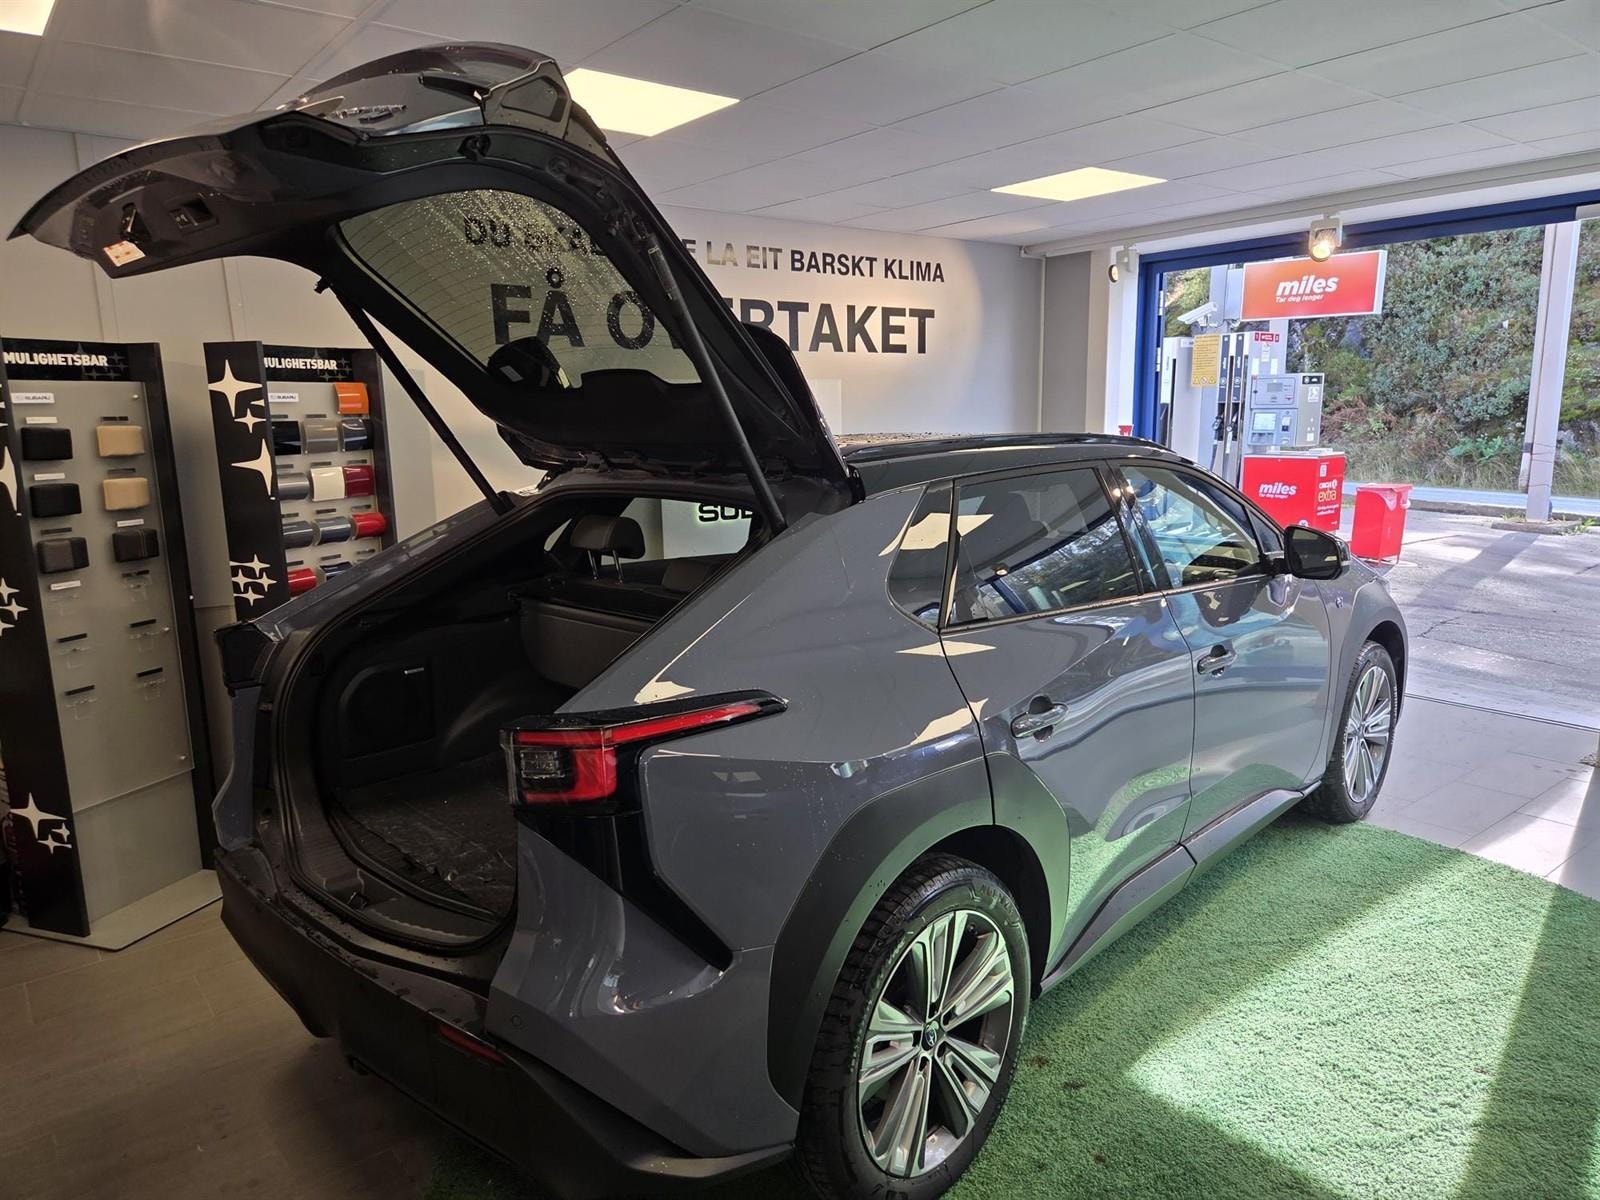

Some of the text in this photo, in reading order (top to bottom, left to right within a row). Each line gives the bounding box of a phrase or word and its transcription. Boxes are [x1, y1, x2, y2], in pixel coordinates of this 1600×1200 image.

[706, 240, 738, 267] LA
[746, 244, 783, 271] EIT
[790, 249, 877, 278] BARSKT
[884, 258, 945, 283] KLIMA
[1275, 275, 1339, 296] miles
[490, 266, 585, 348] FÅ
[2, 351, 108, 367] MULIGHETSBAR
[1258, 482, 1297, 497] miles
